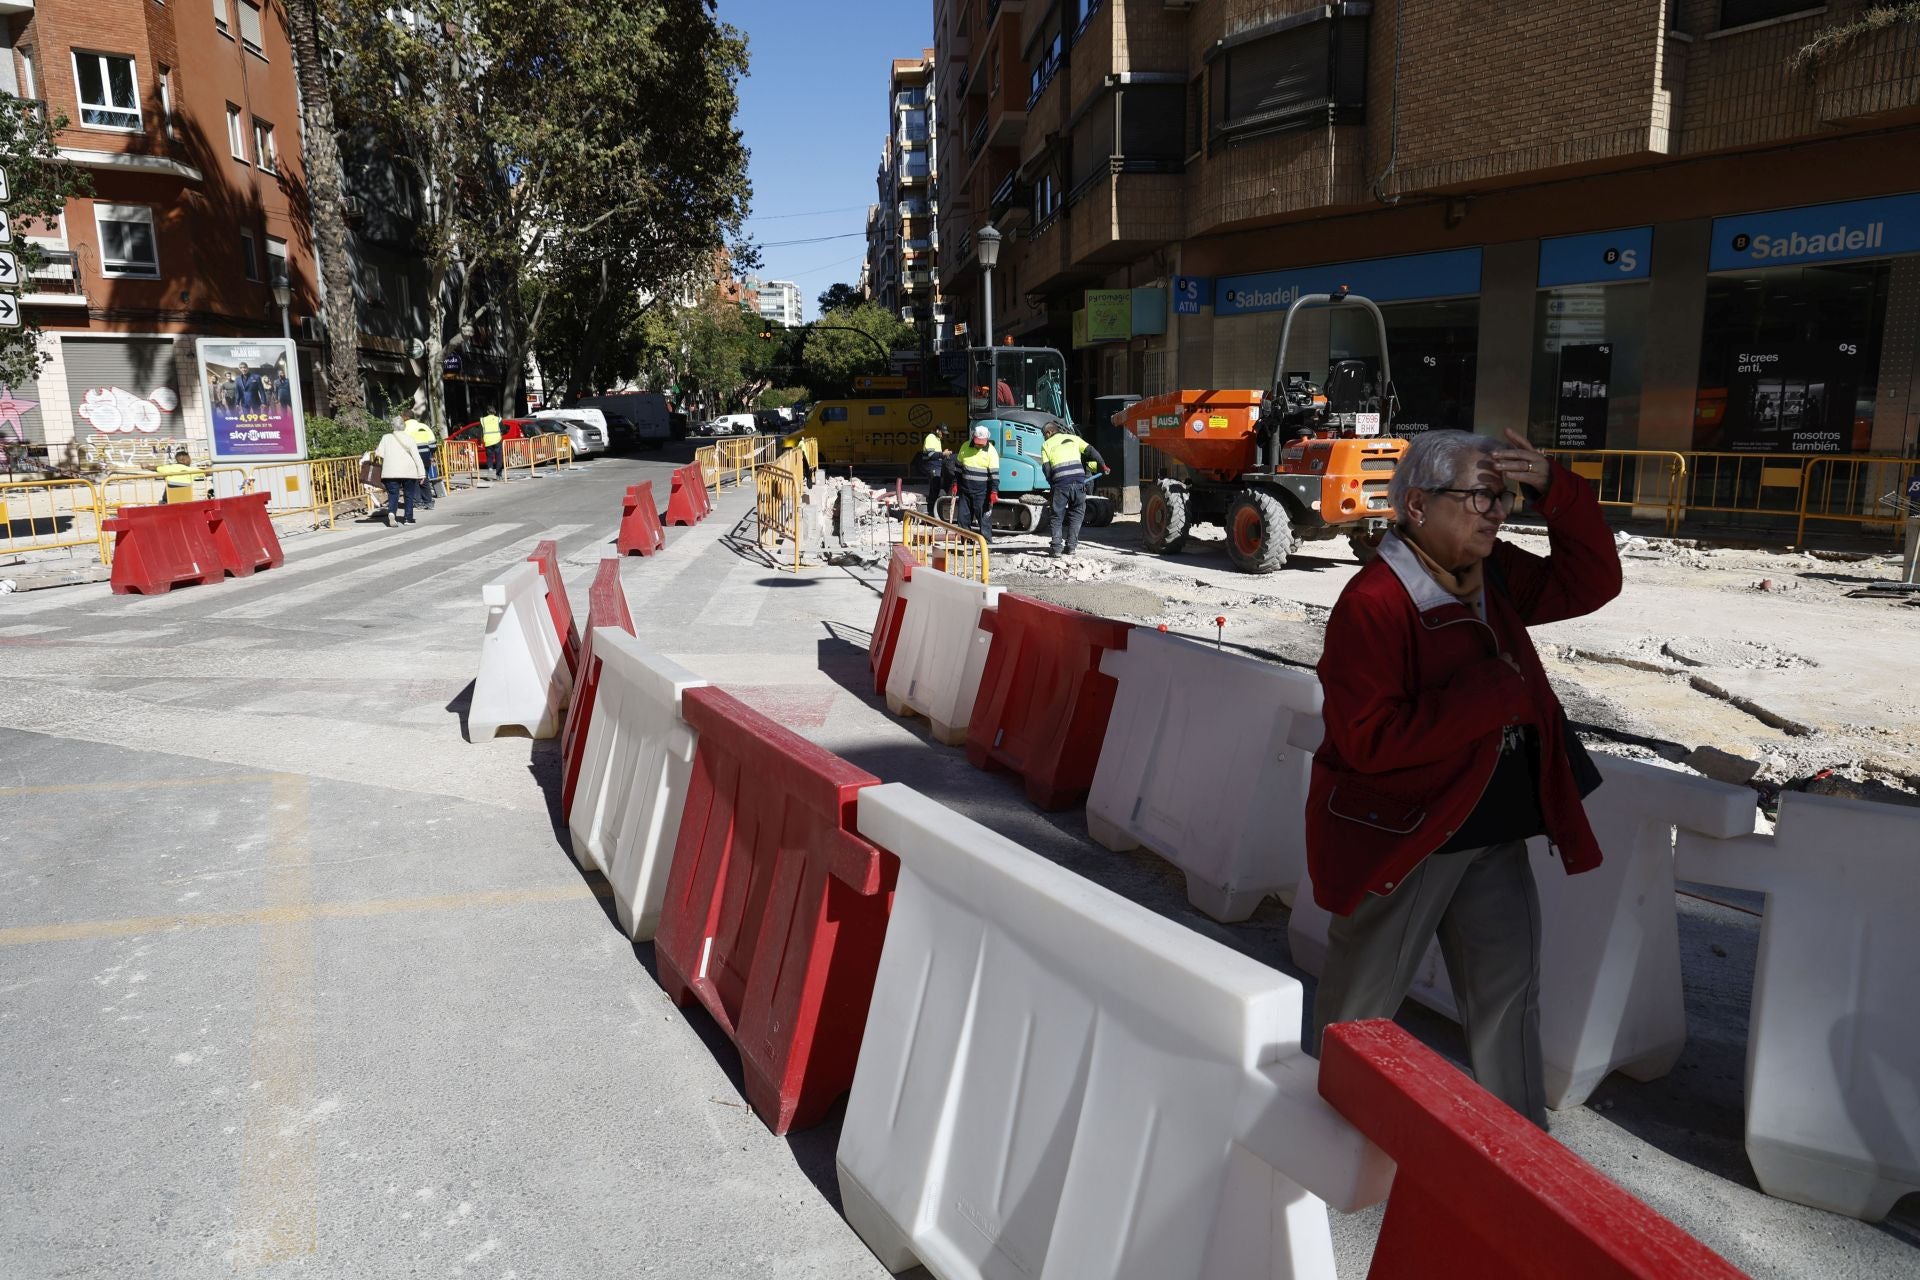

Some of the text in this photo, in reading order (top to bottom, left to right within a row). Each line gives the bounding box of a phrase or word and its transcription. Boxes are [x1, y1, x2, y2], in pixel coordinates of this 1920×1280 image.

[1751, 222, 1884, 260] Sabadell
[1619, 249, 1637, 272] S
[1187, 281, 1198, 299] S
[1088, 294, 1130, 304] pyromagic
[1235, 285, 1300, 308] Sabadell
[1178, 301, 1198, 313] ATM
[1738, 353, 1779, 363] Si crees
[1737, 363, 1762, 373] en ti,
[239, 414, 258, 422] 4,99
[1158, 416, 1179, 426] AUSA
[1360, 424, 1375, 433] BHK
[1396, 422, 1429, 430] nosotros
[1792, 431, 1841, 440] nosotros
[1792, 441, 1841, 451] también.
